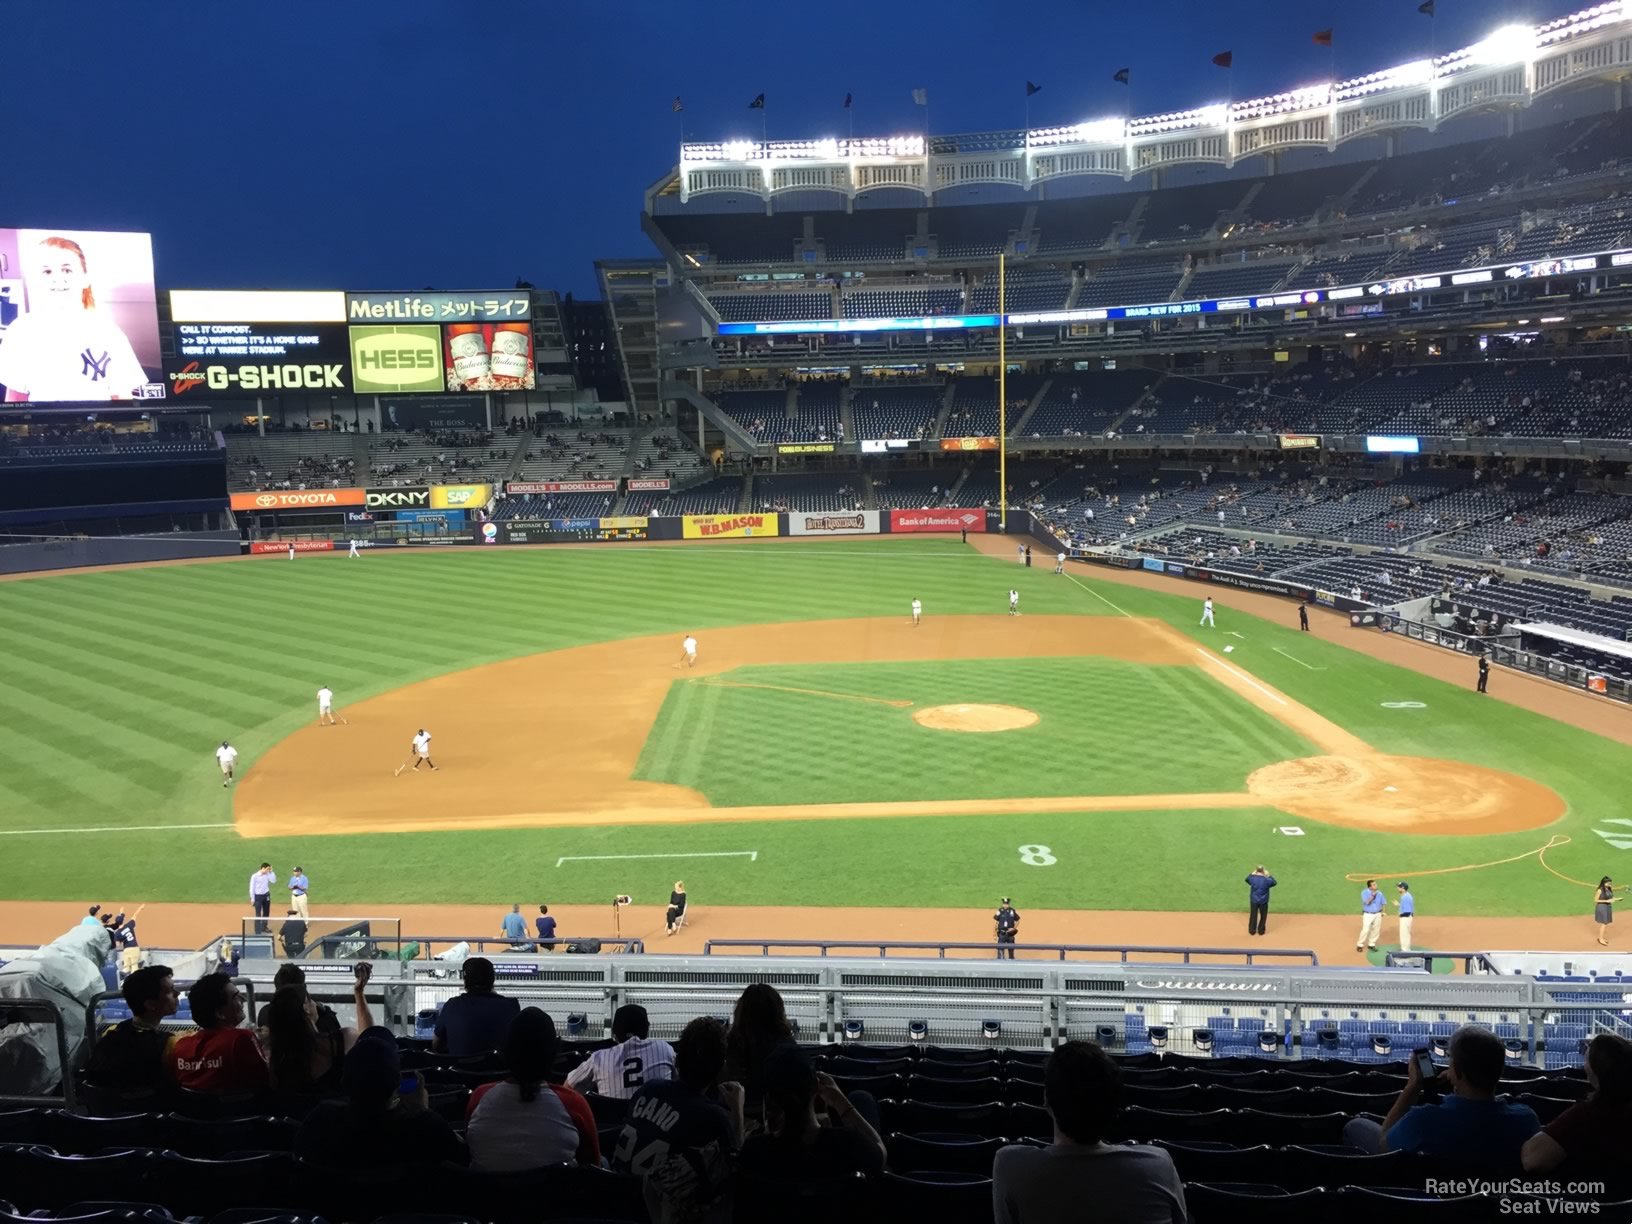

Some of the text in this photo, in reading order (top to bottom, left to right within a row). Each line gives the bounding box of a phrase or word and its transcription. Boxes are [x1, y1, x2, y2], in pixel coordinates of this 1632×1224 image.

[350, 297, 529, 318] MetLife メットライフ
[1168, 304, 1182, 314] FOR
[1183, 303, 1201, 313] 2015
[360, 349, 434, 370] HESS
[170, 372, 206, 381] G-SHOCK
[207, 364, 345, 390] G-SHOCK
[795, 444, 834, 453] BUSINESS
[511, 484, 546, 492] MODELL'S
[560, 483, 613, 491] MODELLS.com
[279, 493, 337, 505] TOYOTA
[366, 491, 429, 506] DKNY
[447, 491, 471, 503] SAP
[349, 512, 373, 521] FedEx
[857, 514, 864, 528] 2
[899, 517, 959, 526] Bank of America
[571, 519, 591, 528] pepsi
[1018, 844, 1057, 867] 8
[623, 1057, 643, 1089] 2
[632, 1095, 680, 1132] CANO
